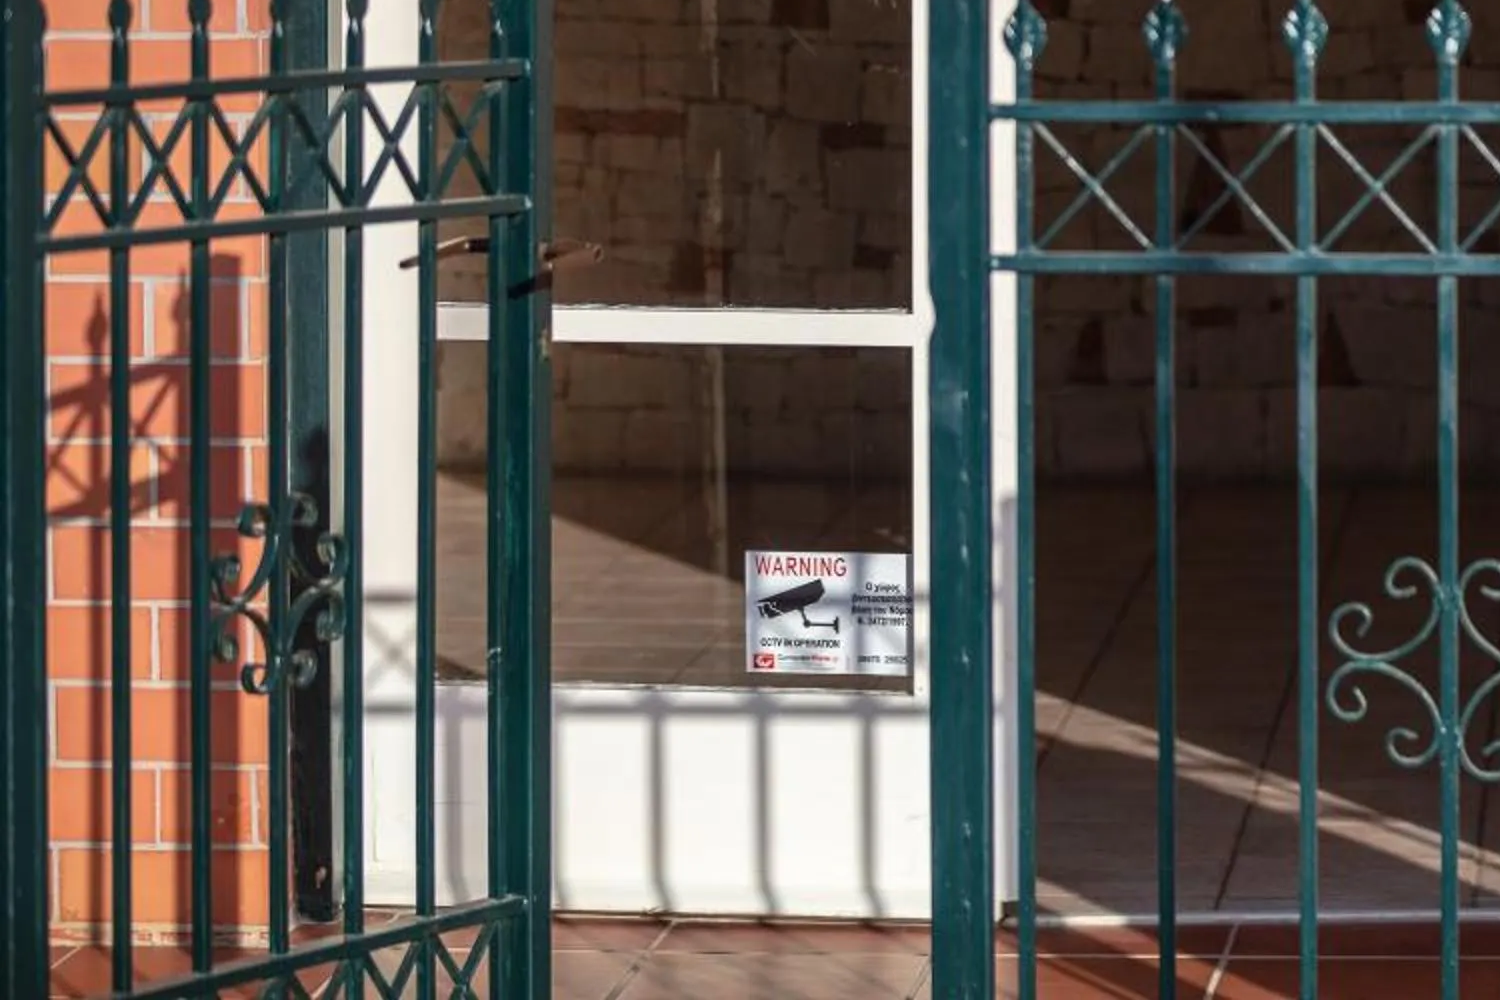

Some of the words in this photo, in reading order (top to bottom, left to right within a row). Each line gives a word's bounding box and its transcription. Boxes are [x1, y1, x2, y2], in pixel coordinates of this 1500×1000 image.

[756, 557, 847, 577] WARNING
[760, 637, 781, 647] CCTV
[794, 638, 841, 649] OPERATION
